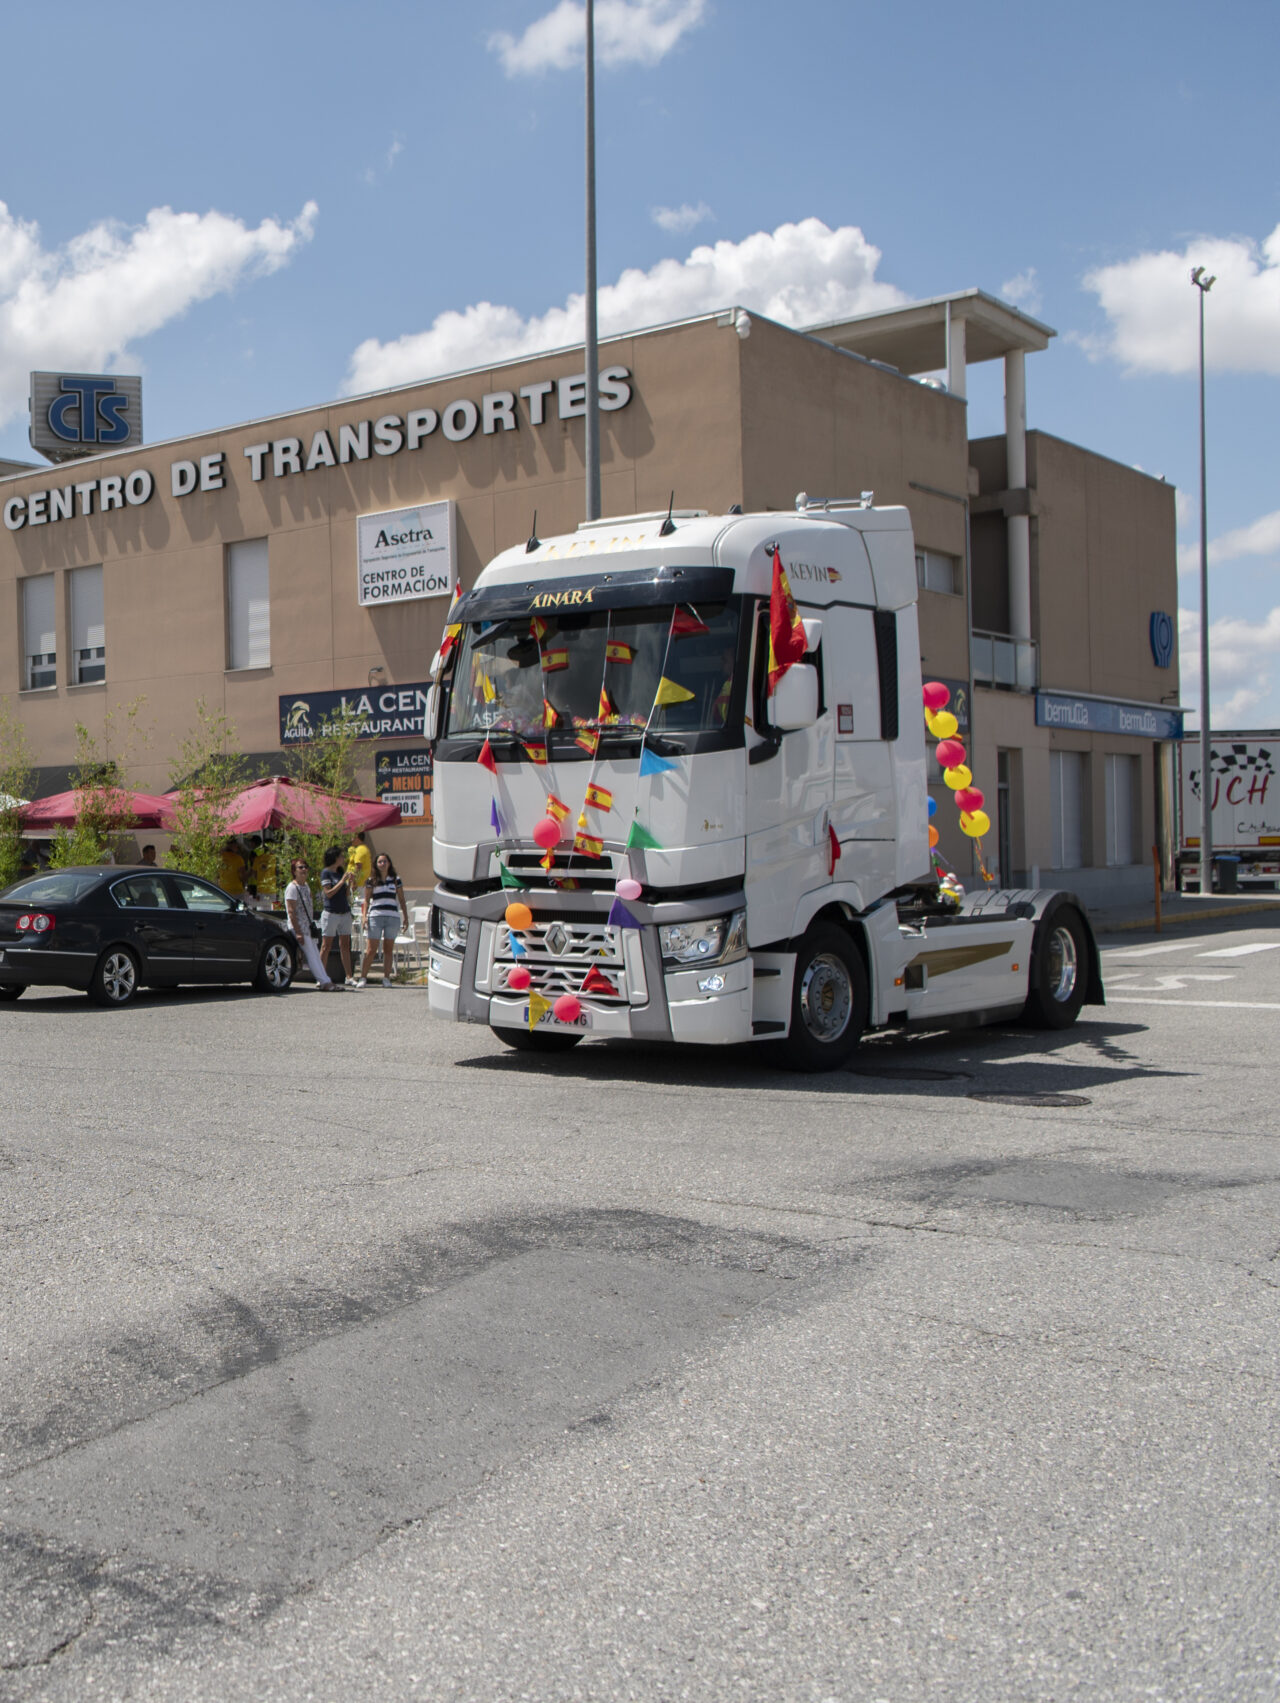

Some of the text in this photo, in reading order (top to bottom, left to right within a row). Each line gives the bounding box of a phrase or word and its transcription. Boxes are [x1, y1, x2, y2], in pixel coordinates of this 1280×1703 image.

[48, 376, 130, 443] CTS
[3, 366, 632, 531] CENTRO DE TRANSPORTES
[375, 528, 434, 548] Asetra
[363, 565, 425, 584] CENTRO DE
[789, 562, 827, 582] KEVIN
[363, 574, 448, 599] FORMACIÓN
[341, 690, 428, 716] LA CEN
[322, 717, 424, 737] RESTAURANT
[397, 755, 431, 767] LA CEN
[393, 773, 421, 791] MENÚ
